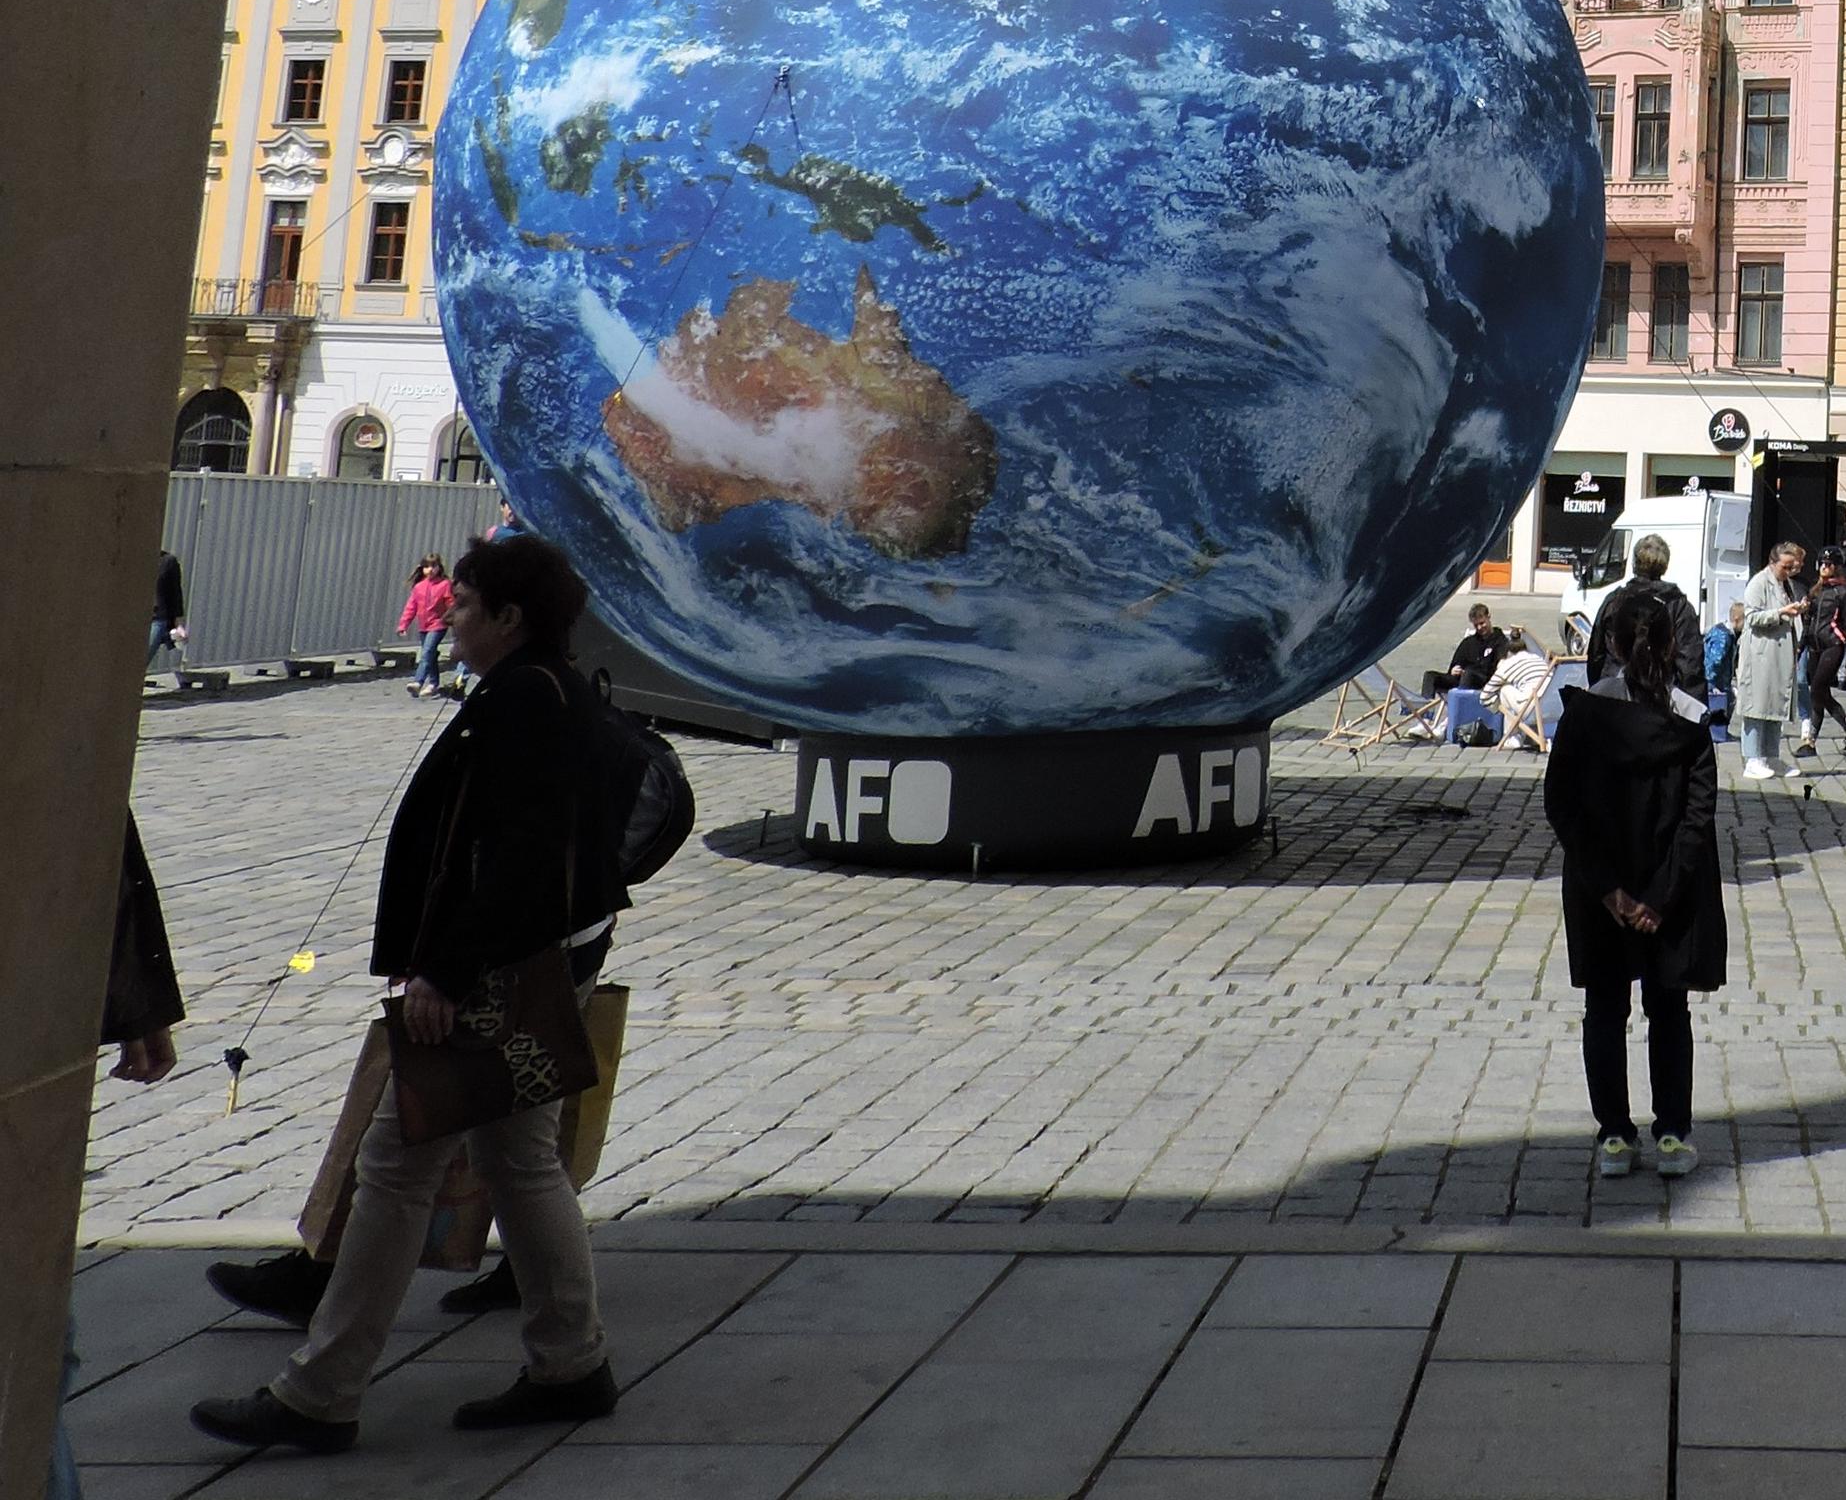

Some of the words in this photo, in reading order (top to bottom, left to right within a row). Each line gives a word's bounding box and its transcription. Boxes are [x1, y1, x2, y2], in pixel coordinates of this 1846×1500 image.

[391, 381, 449, 399] drogerie
[1767, 441, 1792, 450] KOMA
[1563, 497, 1606, 514] ŘEZNICTVÍ
[805, 757, 952, 845] AFO
[1131, 746, 1261, 838] AFO
